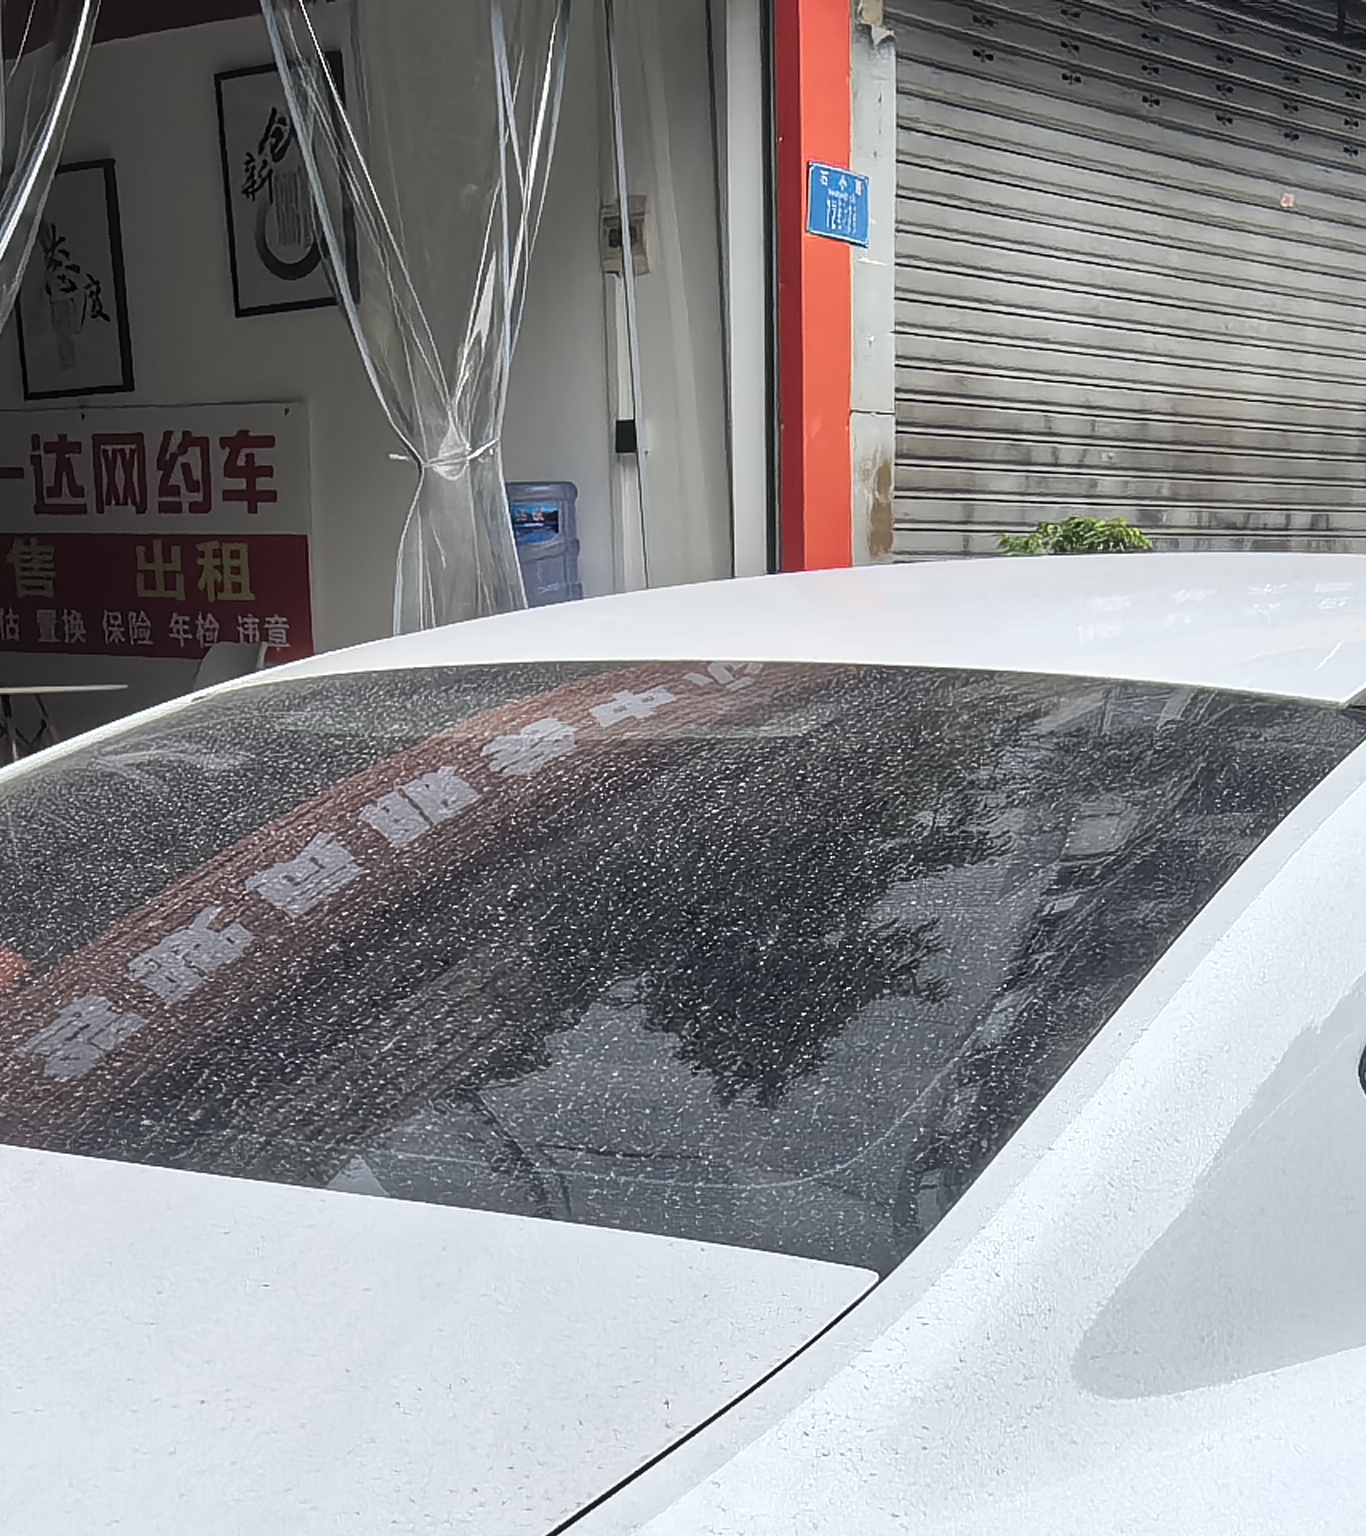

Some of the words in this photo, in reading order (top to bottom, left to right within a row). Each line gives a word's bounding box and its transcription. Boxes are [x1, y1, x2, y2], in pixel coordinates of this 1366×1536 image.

[136, 540, 255, 602] 出租
[37, 609, 86, 645] 置换
[102, 609, 154, 646] 保险
[169, 612, 220, 648] 年检
[237, 613, 291, 650] 违章
